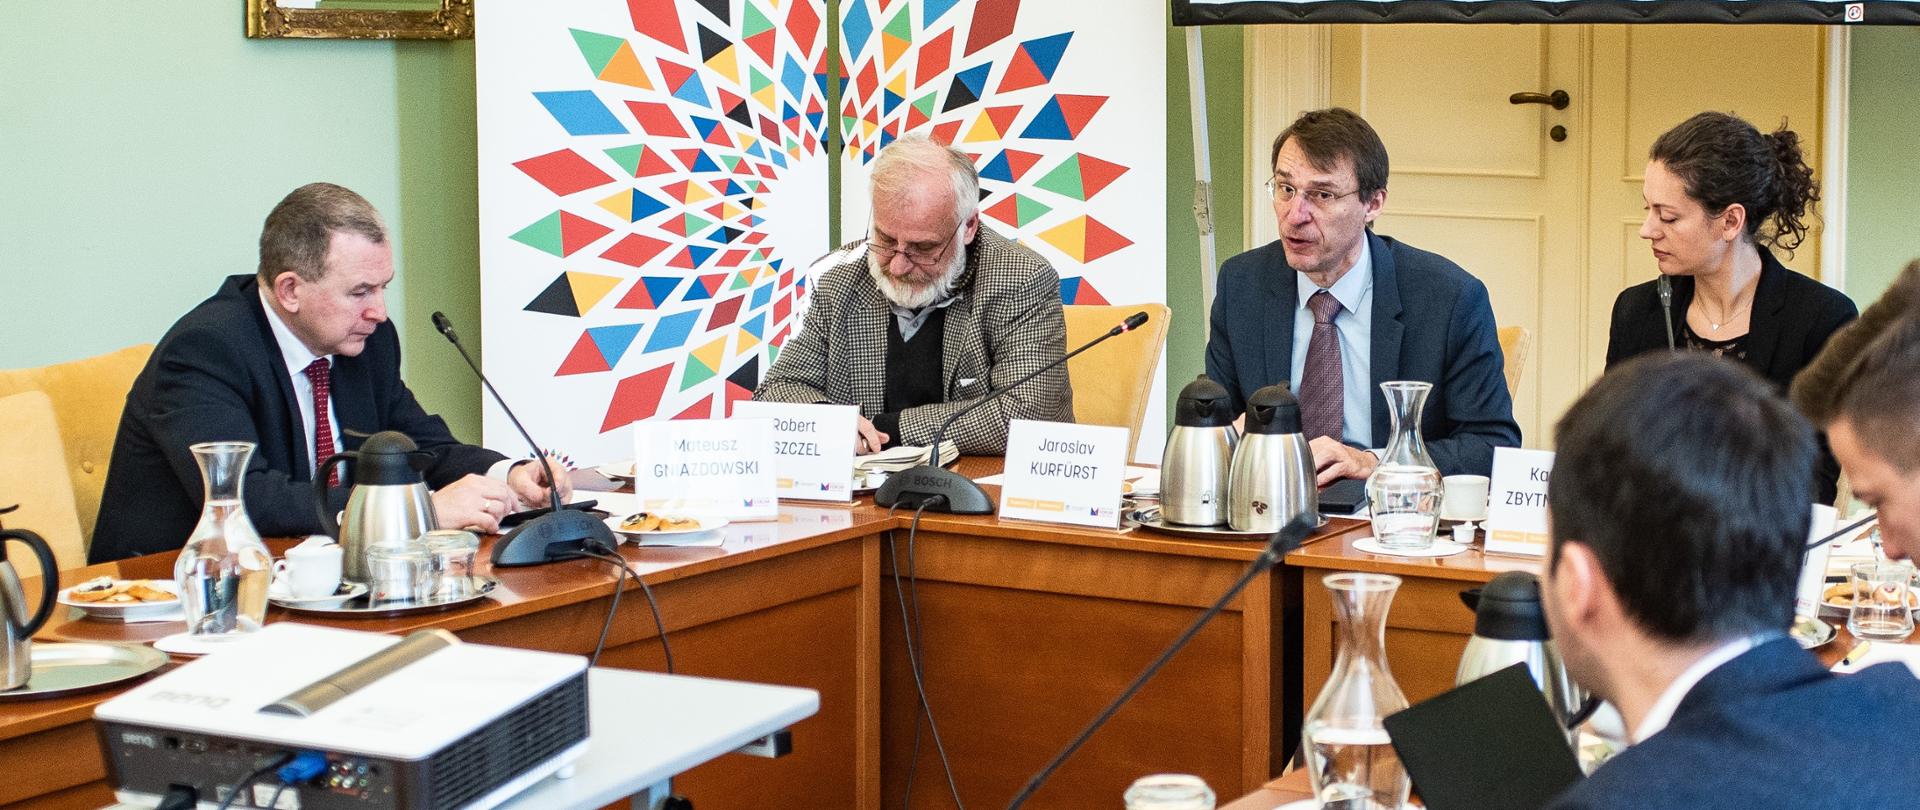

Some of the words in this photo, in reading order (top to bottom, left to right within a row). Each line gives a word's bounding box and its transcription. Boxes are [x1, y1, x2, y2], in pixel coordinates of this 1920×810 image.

[773, 418, 816, 433] Robert
[673, 438, 738, 453] Mateusz
[1038, 438, 1095, 455] Jaroslav
[1030, 460, 1099, 480] KURFÜRST
[913, 475, 952, 489] BOSCH
